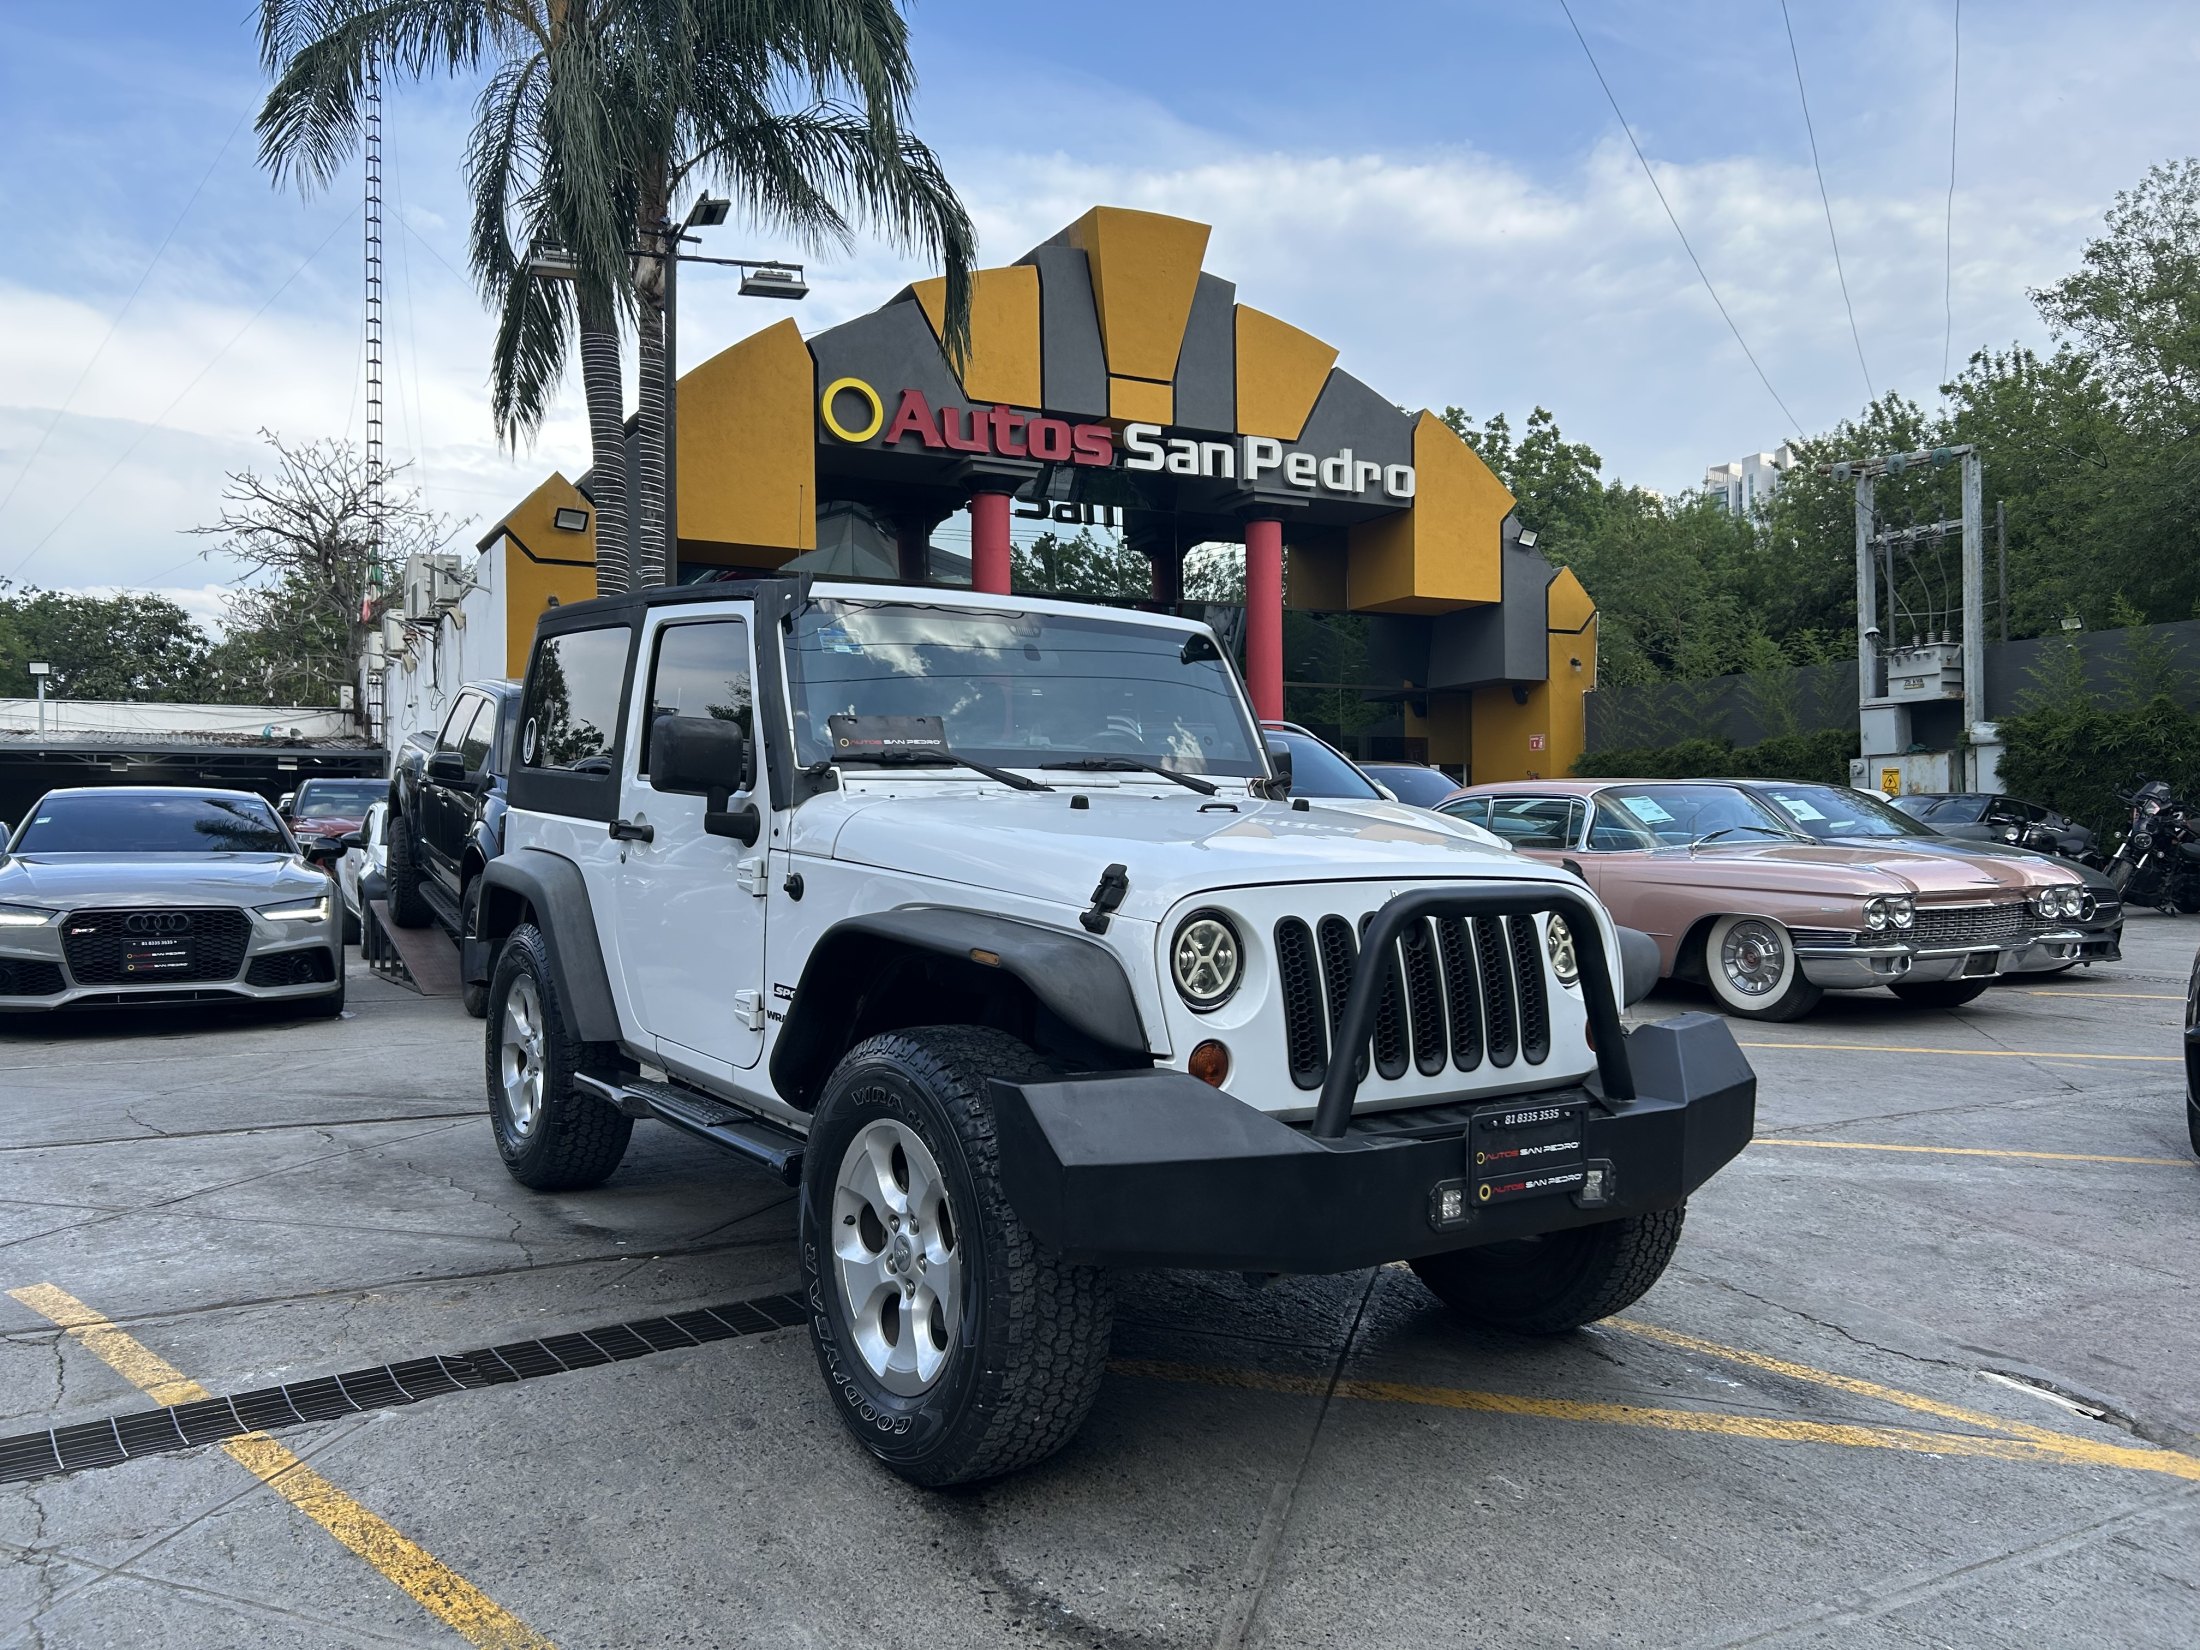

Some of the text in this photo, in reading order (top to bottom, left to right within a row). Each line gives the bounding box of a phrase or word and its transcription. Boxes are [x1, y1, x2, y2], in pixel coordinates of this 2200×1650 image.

[884, 389, 1416, 498] Autos San Pedro
[1505, 1109, 1559, 1125] 81 8335 3535
[1486, 1142, 1580, 1160] AUTOS SAN PEDRO
[1493, 1183, 1525, 1193] AUTOS
[1525, 1178, 1547, 1189] SAN
[804, 1242, 912, 1435] GOODYEAR
